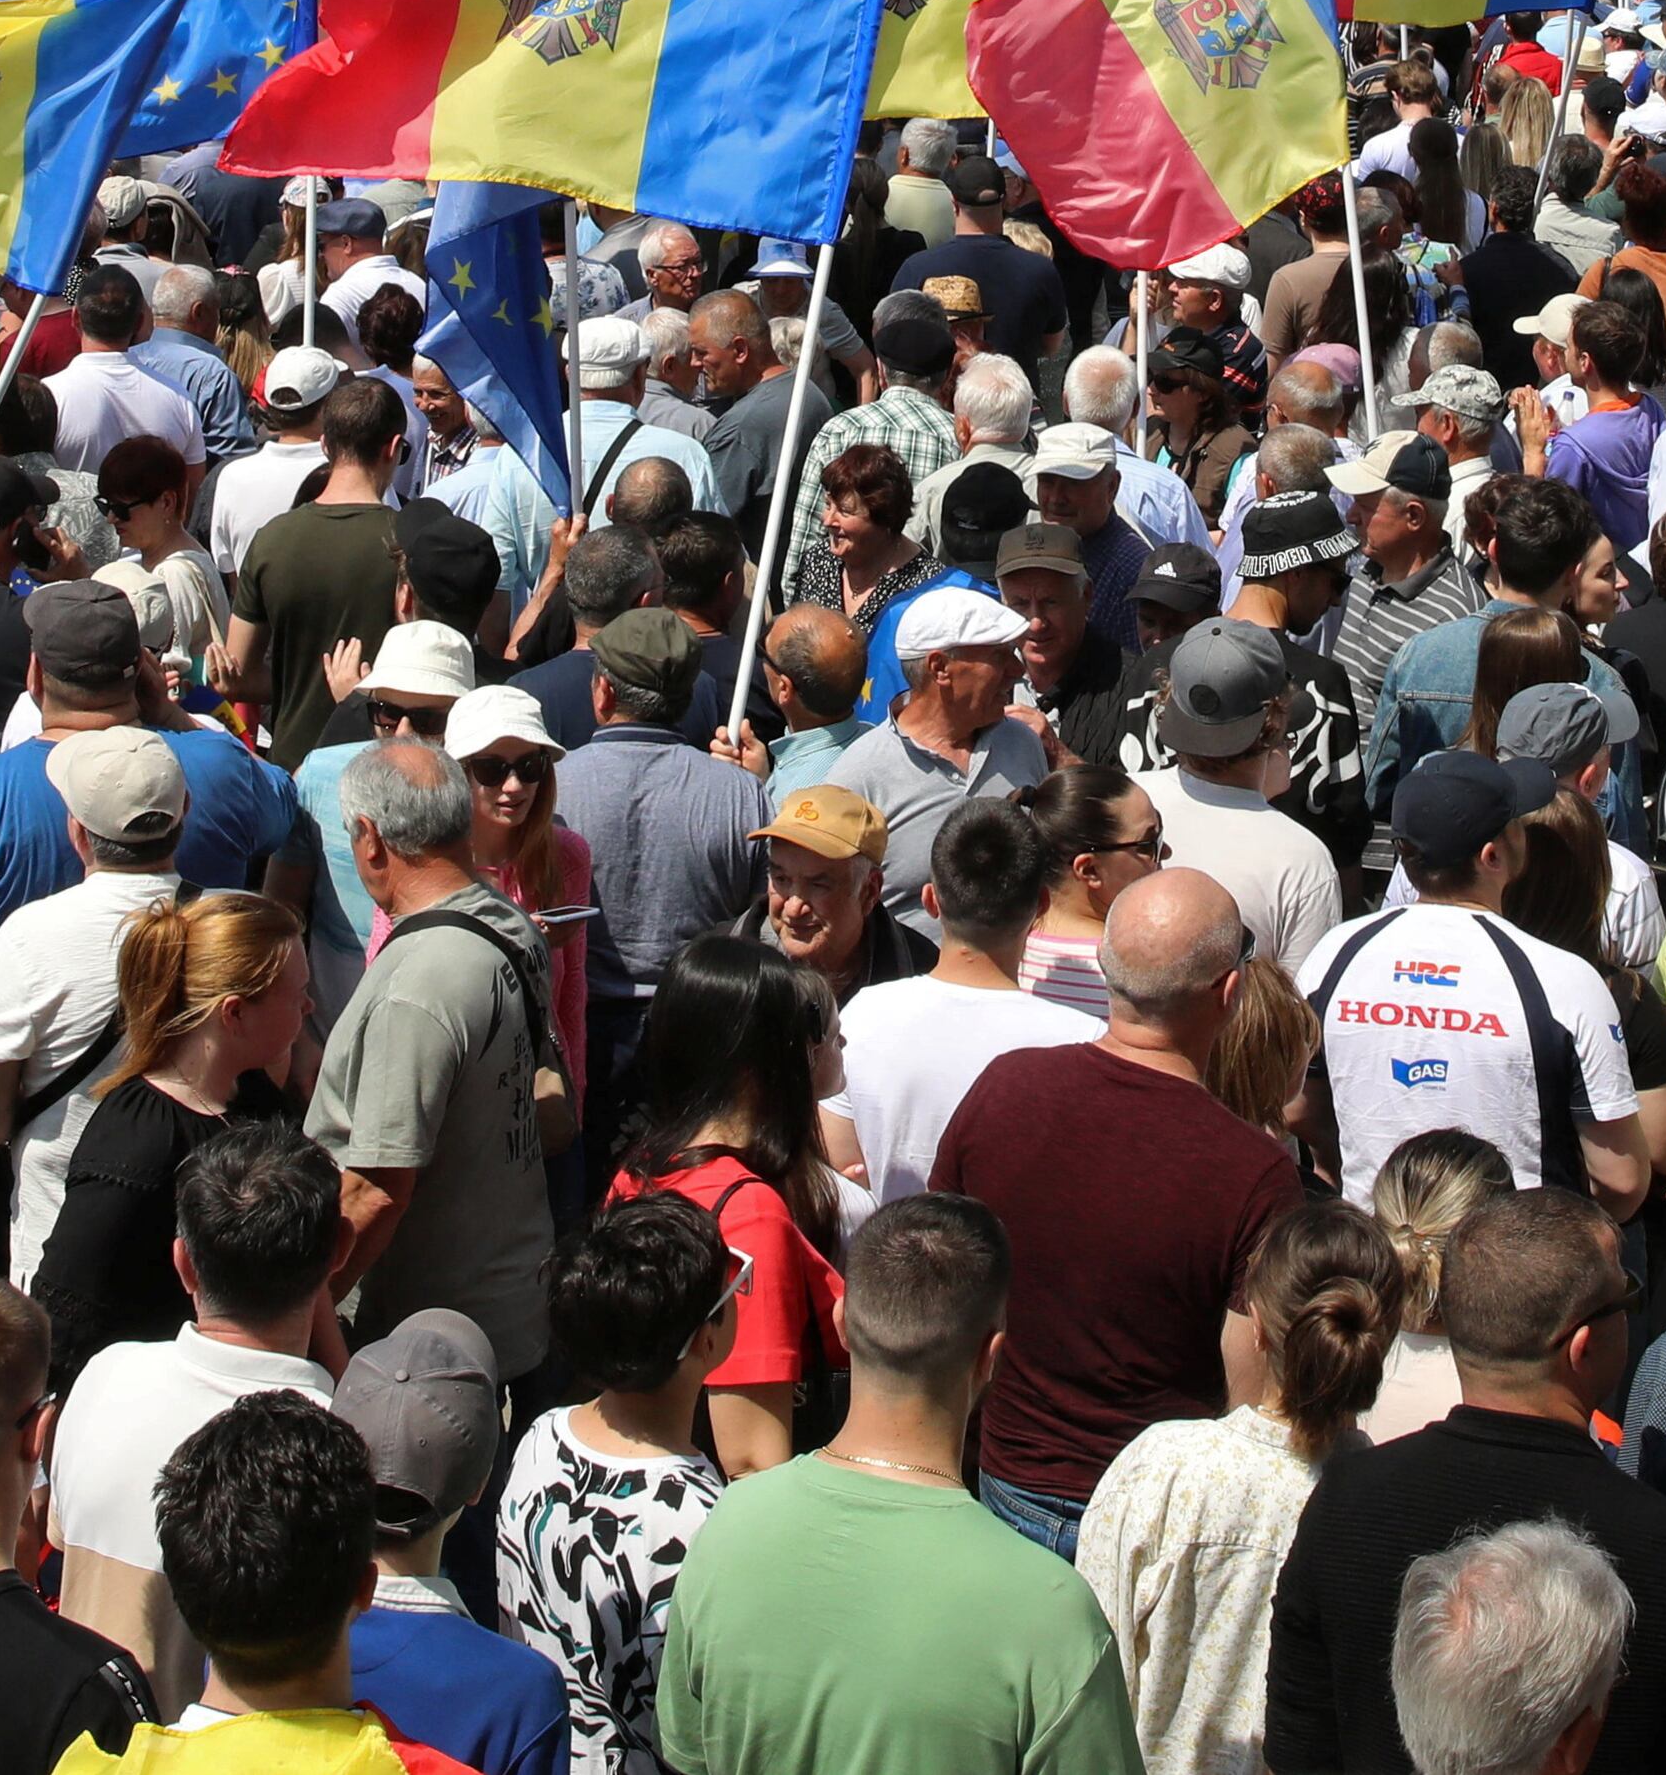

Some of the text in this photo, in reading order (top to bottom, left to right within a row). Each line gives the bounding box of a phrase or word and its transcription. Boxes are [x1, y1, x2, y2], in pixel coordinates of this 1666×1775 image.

[1394, 960, 1461, 987] HRC
[1338, 1000, 1509, 1038] HONDA
[1408, 1063, 1446, 1082] GAS
